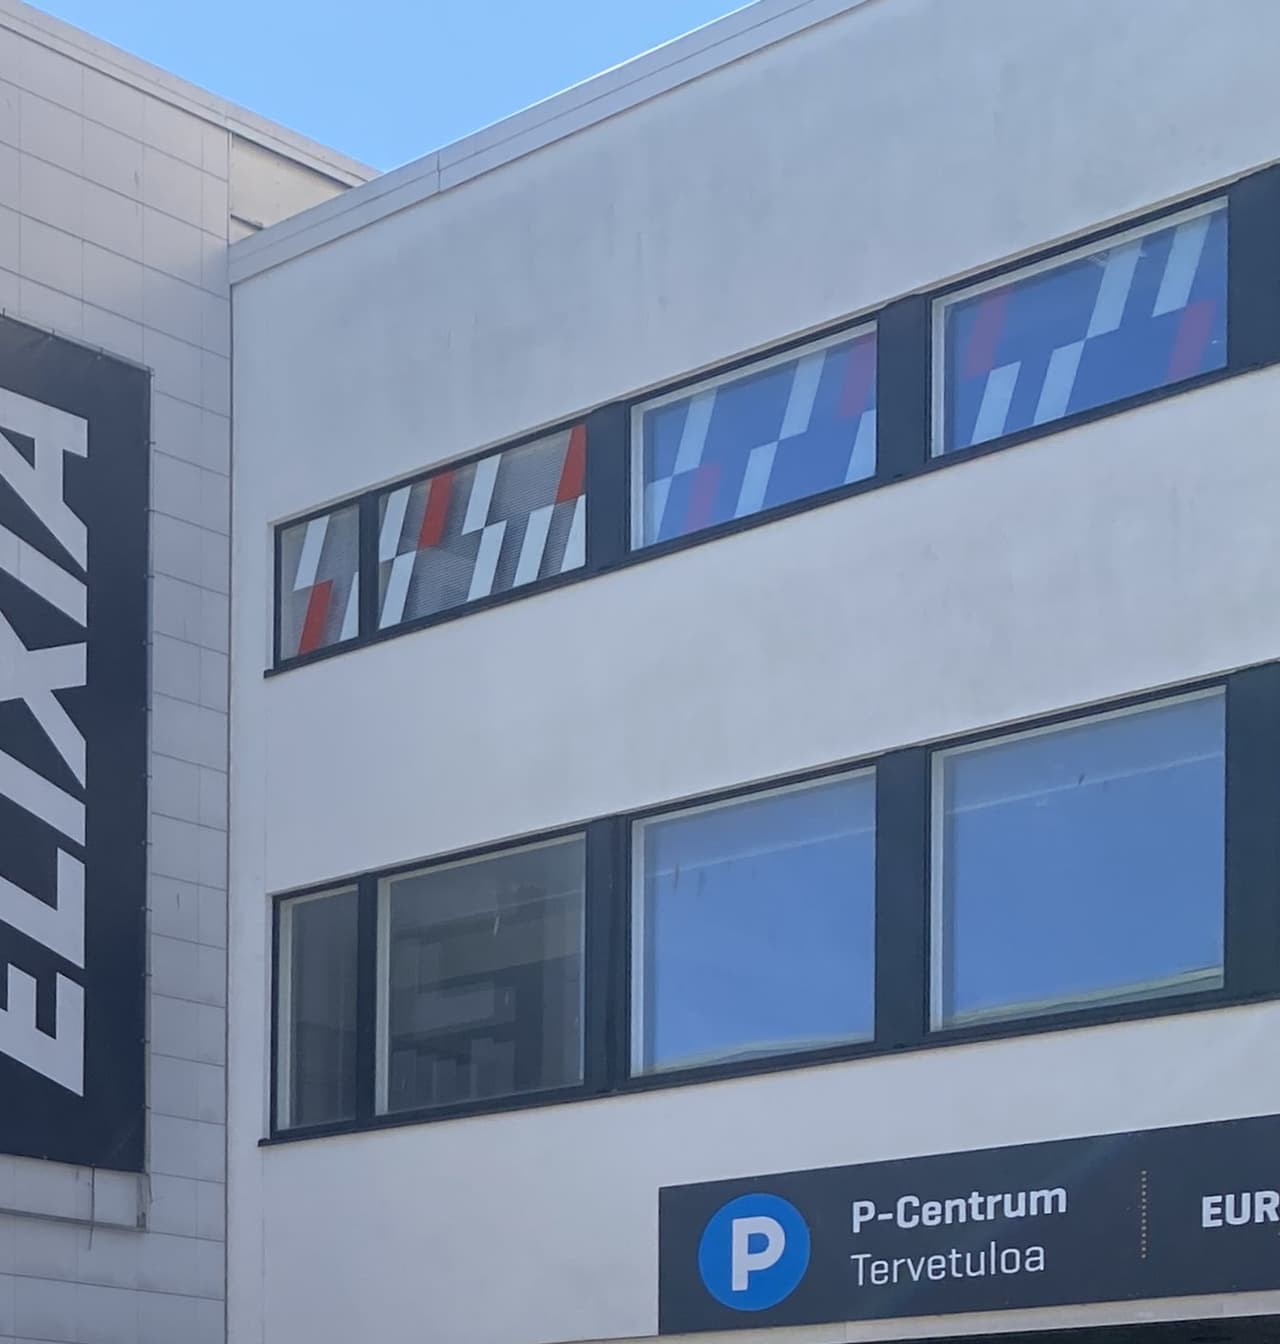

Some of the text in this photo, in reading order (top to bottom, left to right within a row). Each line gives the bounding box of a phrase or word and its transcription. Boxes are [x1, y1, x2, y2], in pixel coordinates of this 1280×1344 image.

[852, 1187, 1067, 1234] P-Centrum
[731, 1216, 786, 1292] P
[850, 1240, 1045, 1287] Tervetuloa
